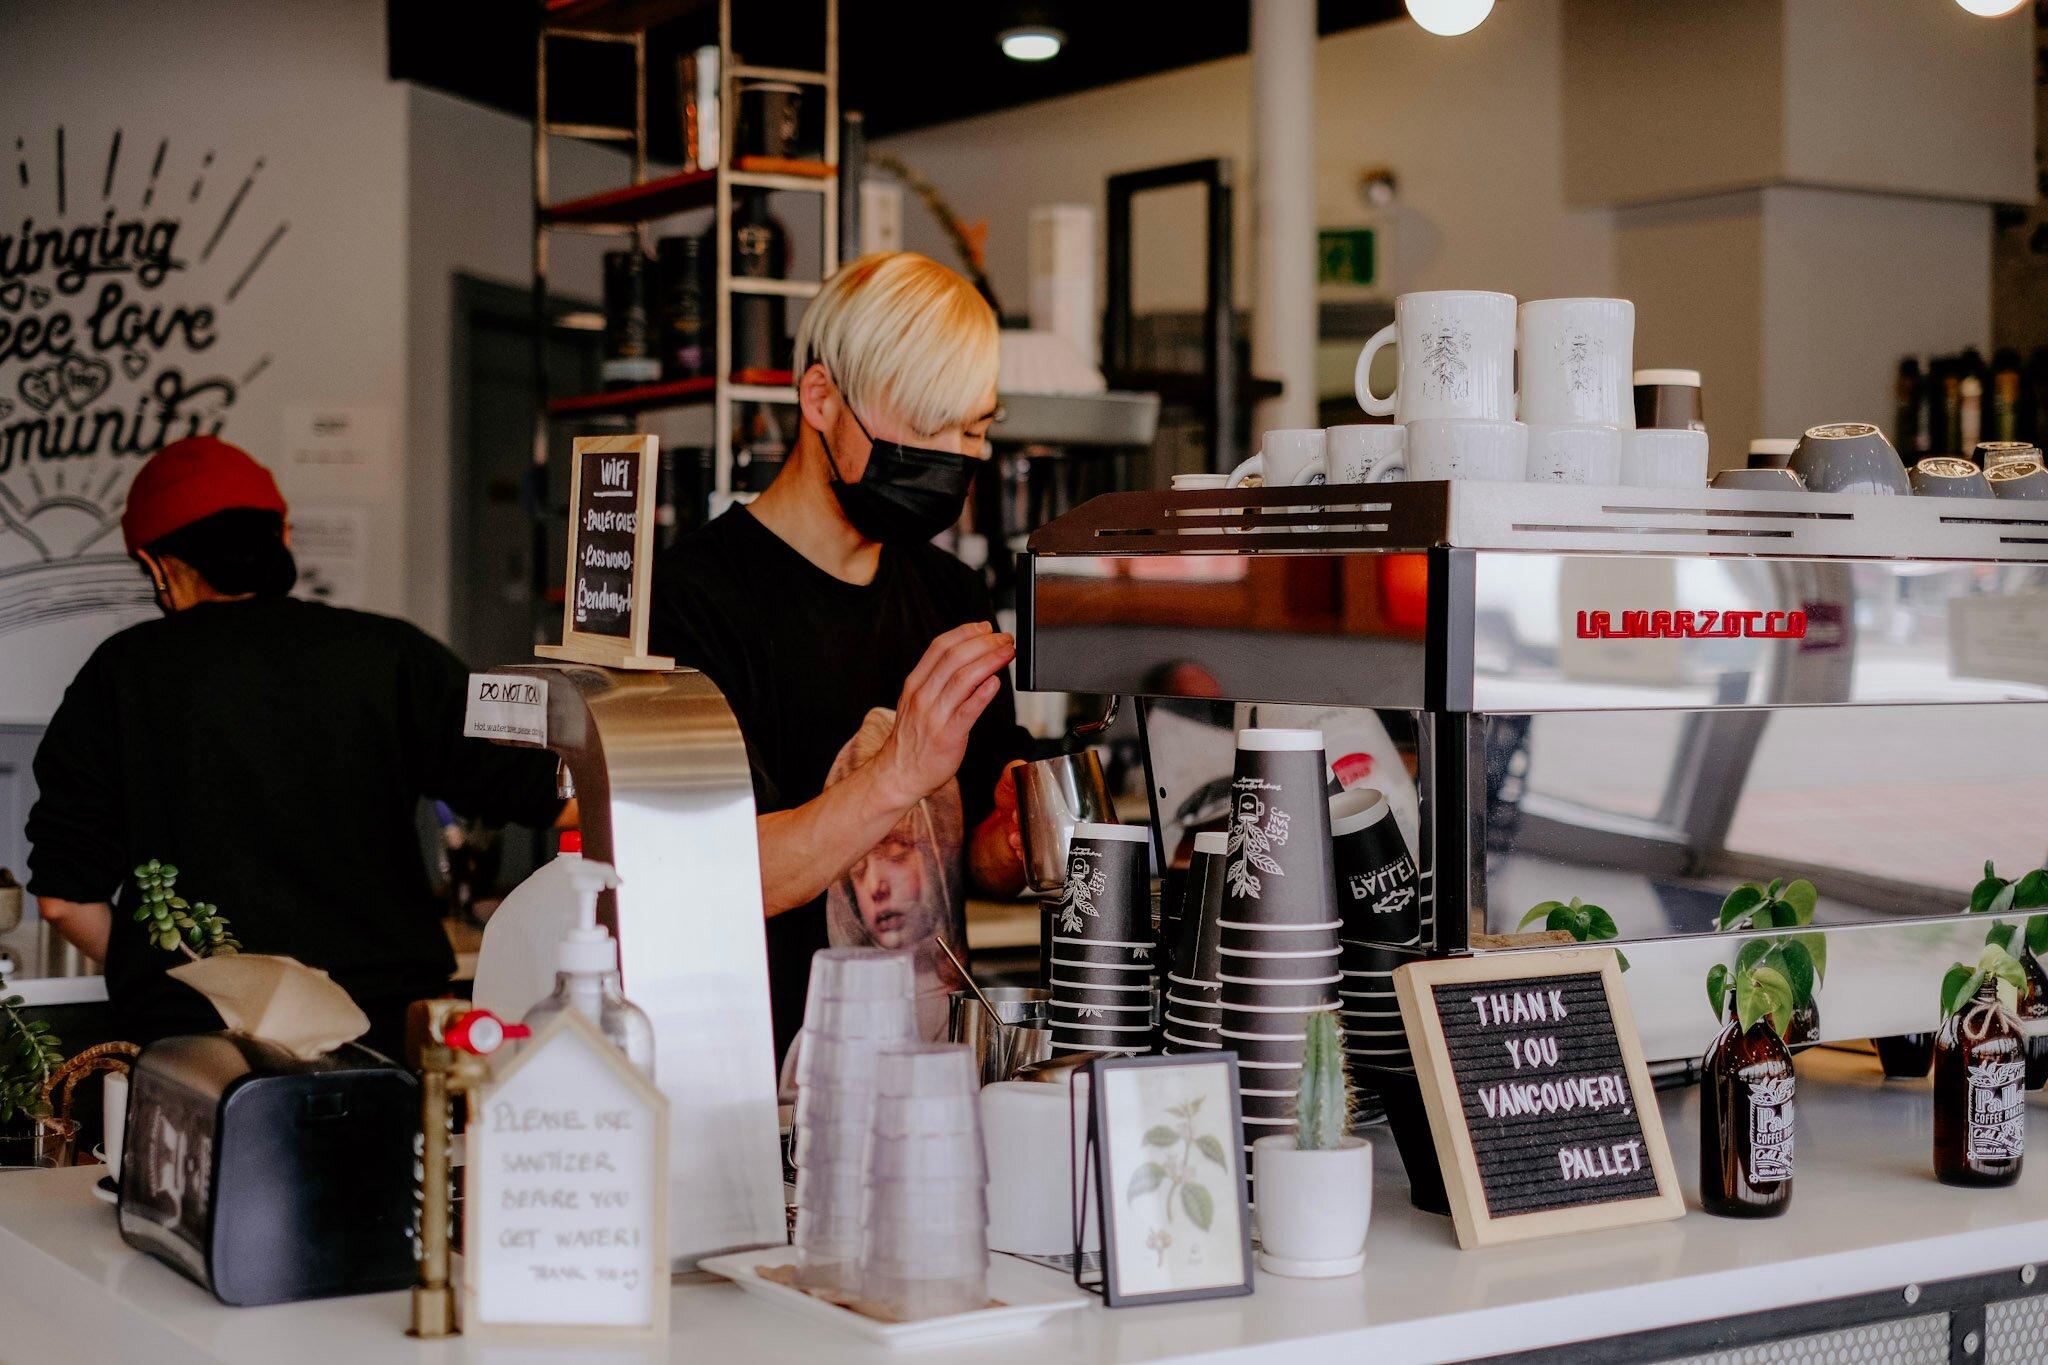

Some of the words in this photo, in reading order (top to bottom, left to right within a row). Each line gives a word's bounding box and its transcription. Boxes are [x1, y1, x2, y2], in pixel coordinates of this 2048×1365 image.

[87, 282, 217, 350] love
[1577, 611, 1611, 638] LA
[1622, 611, 1808, 638] MARZOCCO
[479, 682, 499, 700] DO
[503, 683, 522, 702] NOT
[1471, 990, 1567, 1026] THANK
[1504, 1037, 1558, 1069] YOU
[1478, 1075, 1631, 1118] VANCOUVER!
[493, 1102, 587, 1134] PLEASE
[594, 1109, 633, 1132] USE
[1974, 1112, 2003, 1125] COFFEE
[1756, 1132, 1783, 1145] COFFEE
[1973, 1128, 1994, 1140] Cold
[1558, 1140, 1643, 1181] PALLET
[590, 1190, 630, 1210] YOU
[499, 1228, 541, 1249] GET
[554, 1227, 641, 1249] WATER!
